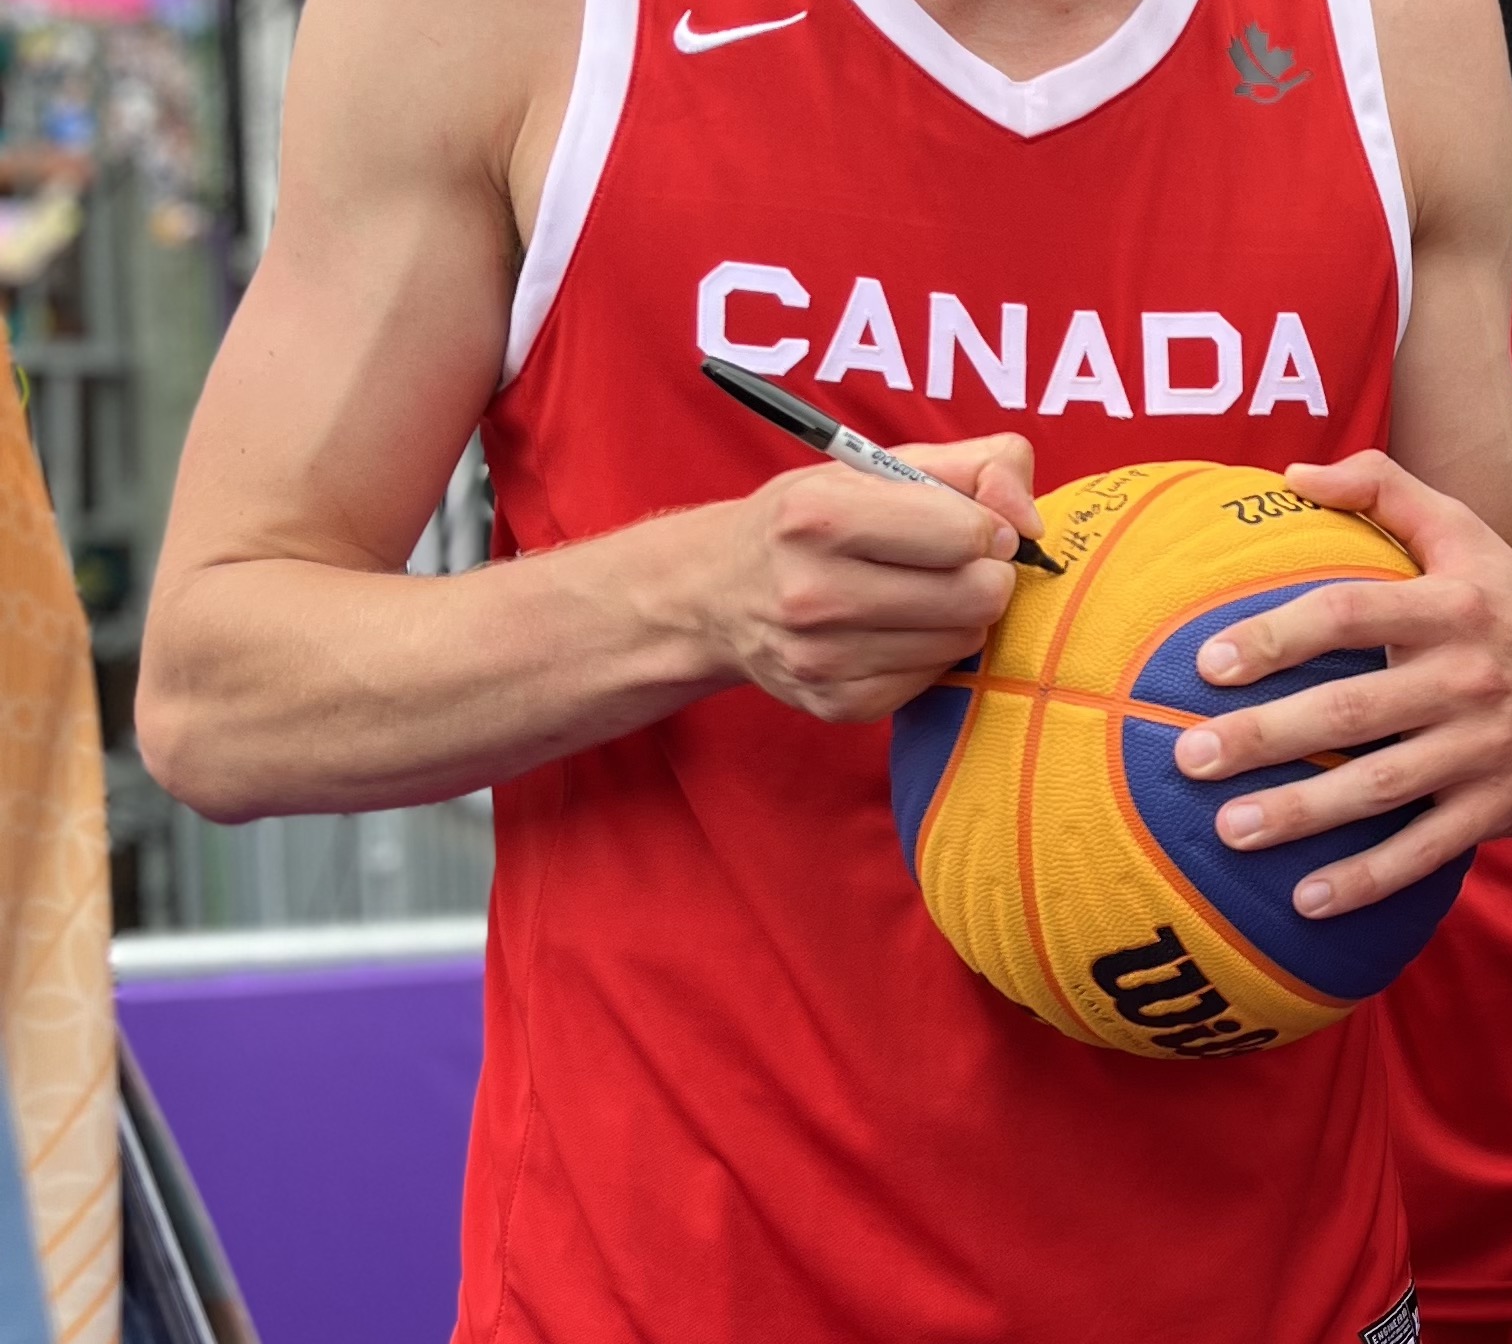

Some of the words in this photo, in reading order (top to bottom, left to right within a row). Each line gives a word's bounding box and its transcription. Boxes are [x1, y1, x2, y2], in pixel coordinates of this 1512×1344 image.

[697, 260, 1330, 418] CANADA
[1221, 490, 1322, 526] 2022
[1092, 925, 1280, 1058] Wil
